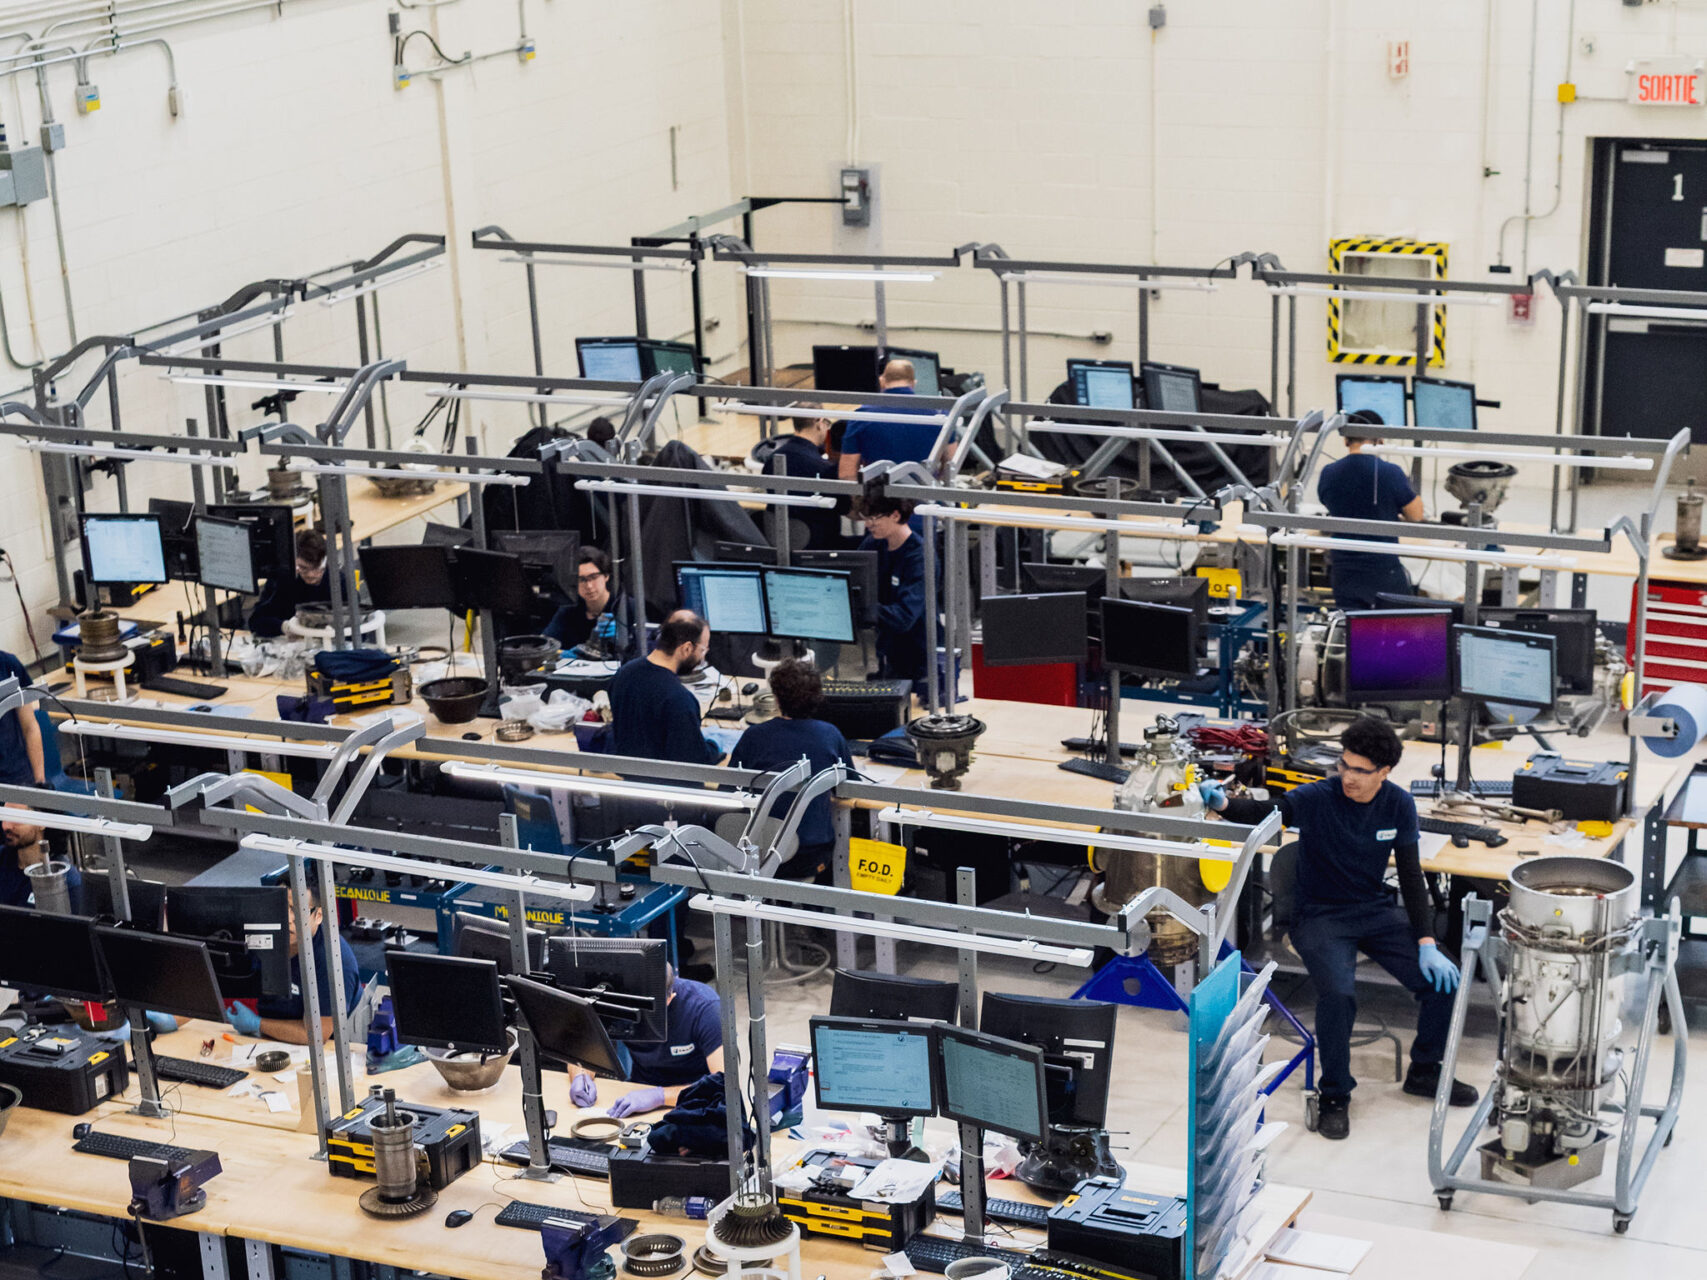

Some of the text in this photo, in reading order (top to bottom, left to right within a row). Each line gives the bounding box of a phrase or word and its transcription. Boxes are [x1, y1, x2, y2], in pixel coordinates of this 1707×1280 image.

[1638, 74, 1698, 104] SORTIE
[1671, 173, 1684, 202] 1
[858, 859, 893, 877] F.O.D.
[334, 885, 391, 903] ECANIQUE
